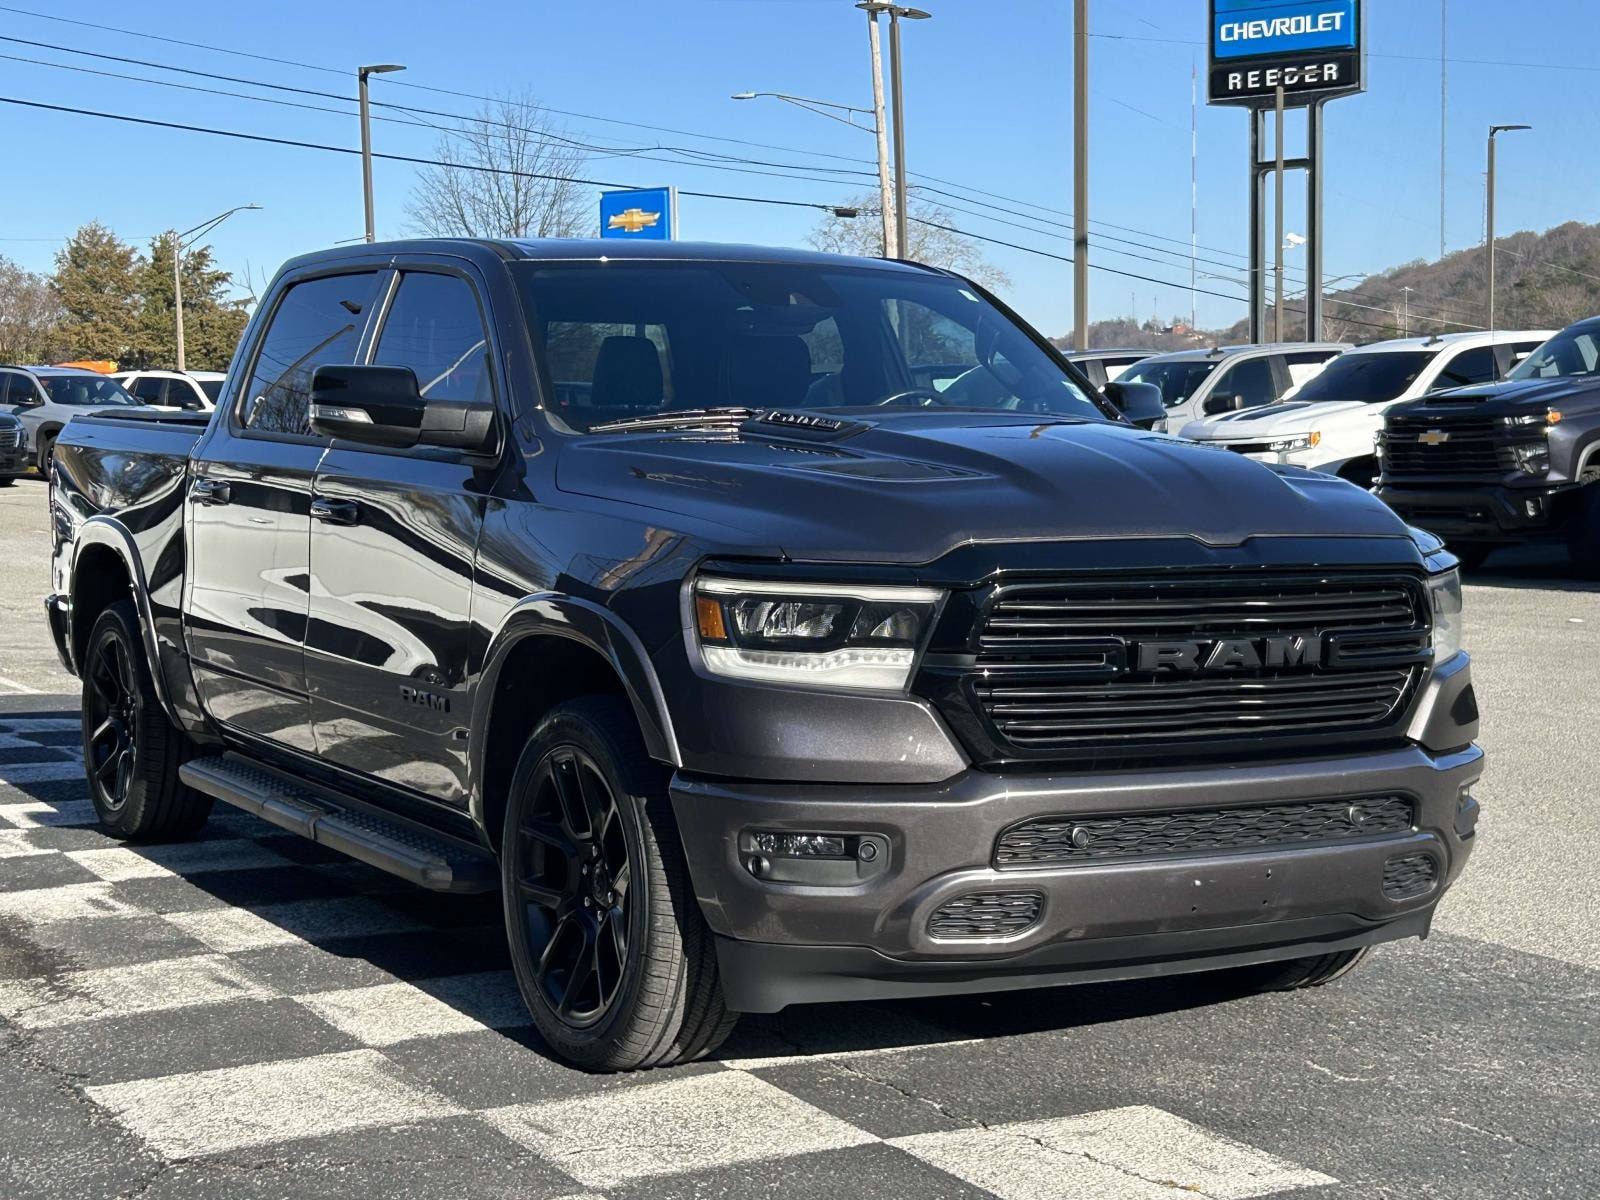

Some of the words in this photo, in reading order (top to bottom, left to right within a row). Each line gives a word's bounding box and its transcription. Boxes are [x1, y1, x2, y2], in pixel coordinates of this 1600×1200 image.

[1220, 12, 1345, 42] CHEVROLET
[1228, 63, 1338, 90] REEDER
[1137, 636, 1322, 672] RAM
[400, 685, 450, 712] RAM
